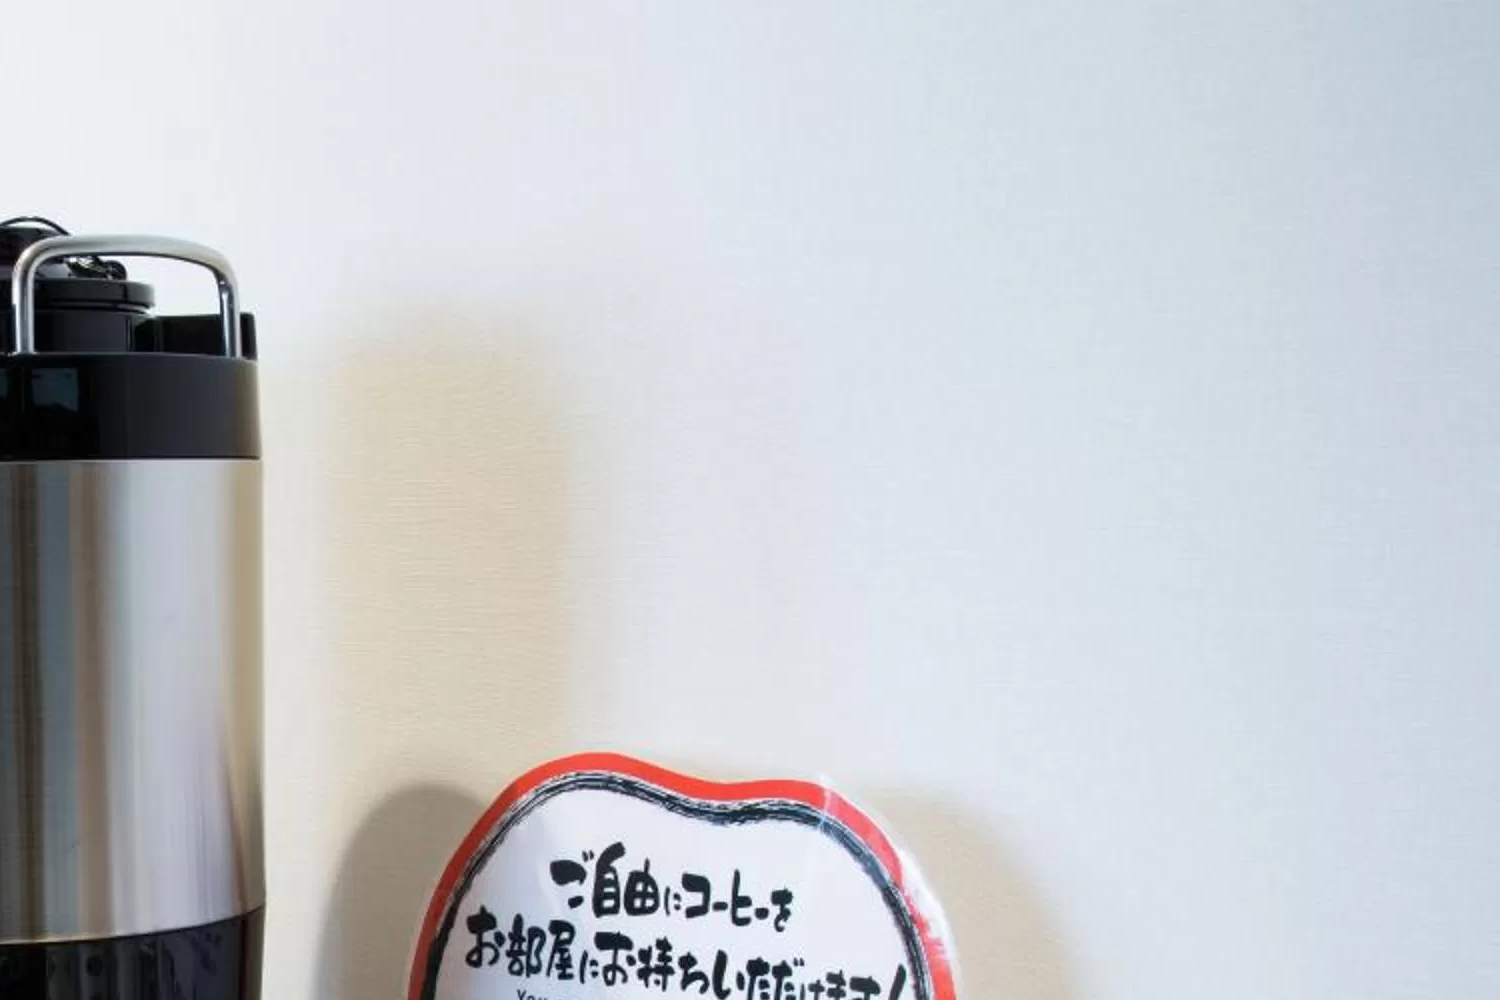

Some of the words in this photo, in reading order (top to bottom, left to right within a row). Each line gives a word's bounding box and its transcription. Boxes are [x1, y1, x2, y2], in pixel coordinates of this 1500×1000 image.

[549, 842, 794, 932] ご自由にコーヒーを
